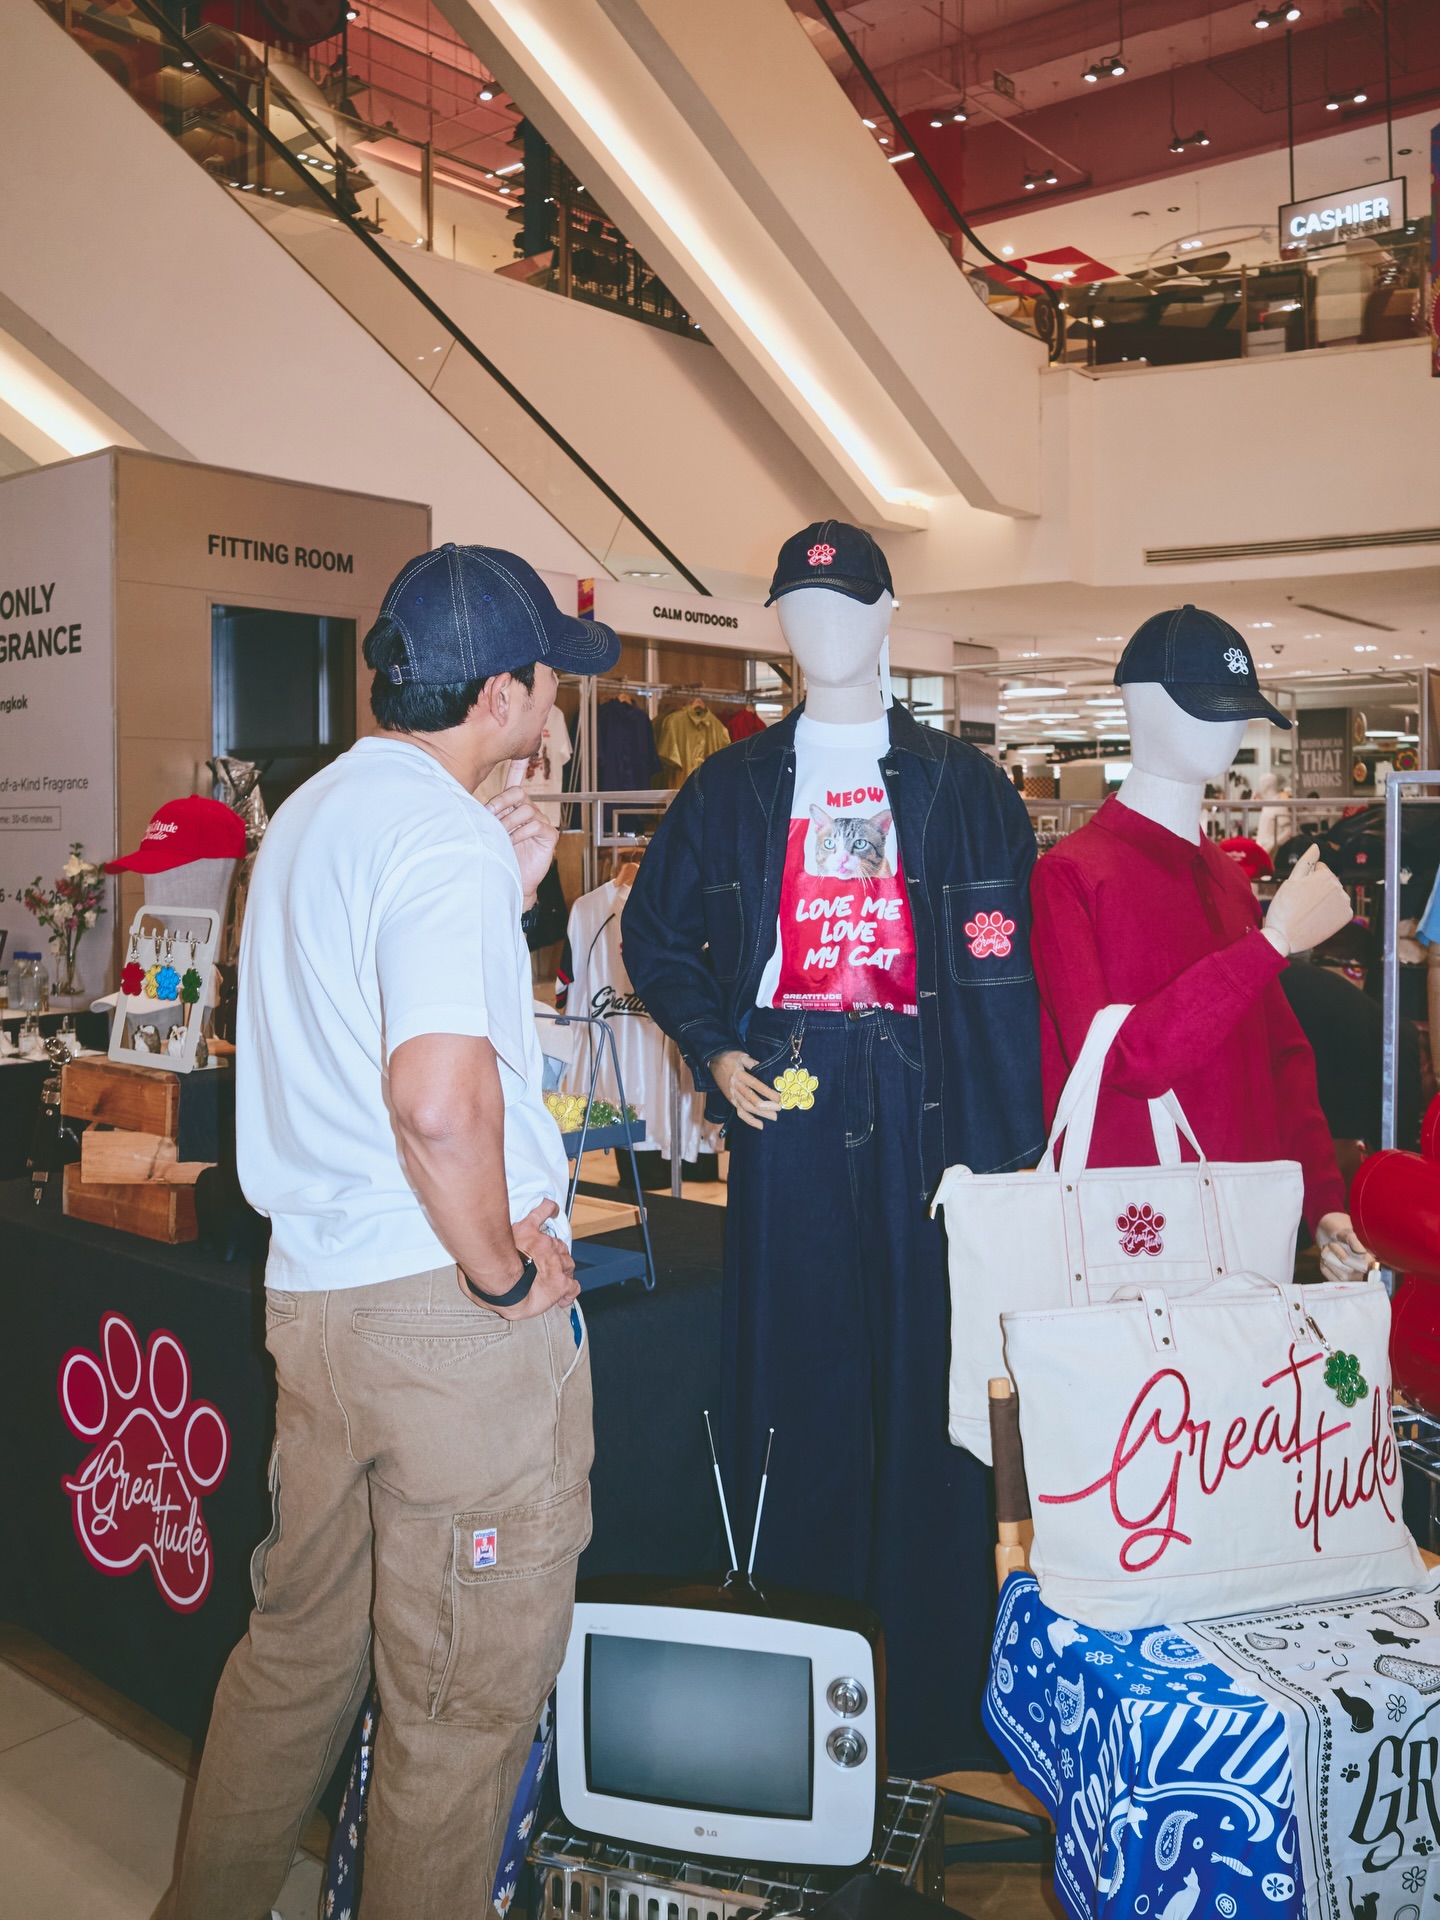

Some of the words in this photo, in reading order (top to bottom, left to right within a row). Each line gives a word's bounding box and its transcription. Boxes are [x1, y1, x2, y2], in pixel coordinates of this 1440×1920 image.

[1290, 197, 1390, 237] CASHIER
[208, 534, 289, 565] FITTING
[295, 547, 353, 574] ROOM
[0, 582, 56, 620] ONLY
[653, 606, 682, 620] CALM
[684, 610, 739, 629] OUTDOORS
[1301, 749, 1343, 772] THAT
[42, 776, 89, 793] Fragrance
[1301, 772, 1343, 788] WORKS
[826, 786, 884, 808] MEOW
[15, 889, 22, 904] 4
[796, 896, 854, 922] LOVE
[861, 896, 903, 921] ME
[820, 920, 878, 944] LOVE
[803, 946, 840, 970] MY
[849, 946, 901, 971] CAT
[1038, 1343, 1323, 1572] Great
[1283, 1386, 1398, 1553] itude
[66, 1439, 178, 1536] Great
[152, 1493, 207, 1574] itude
[706, 1829, 718, 1837] LG
